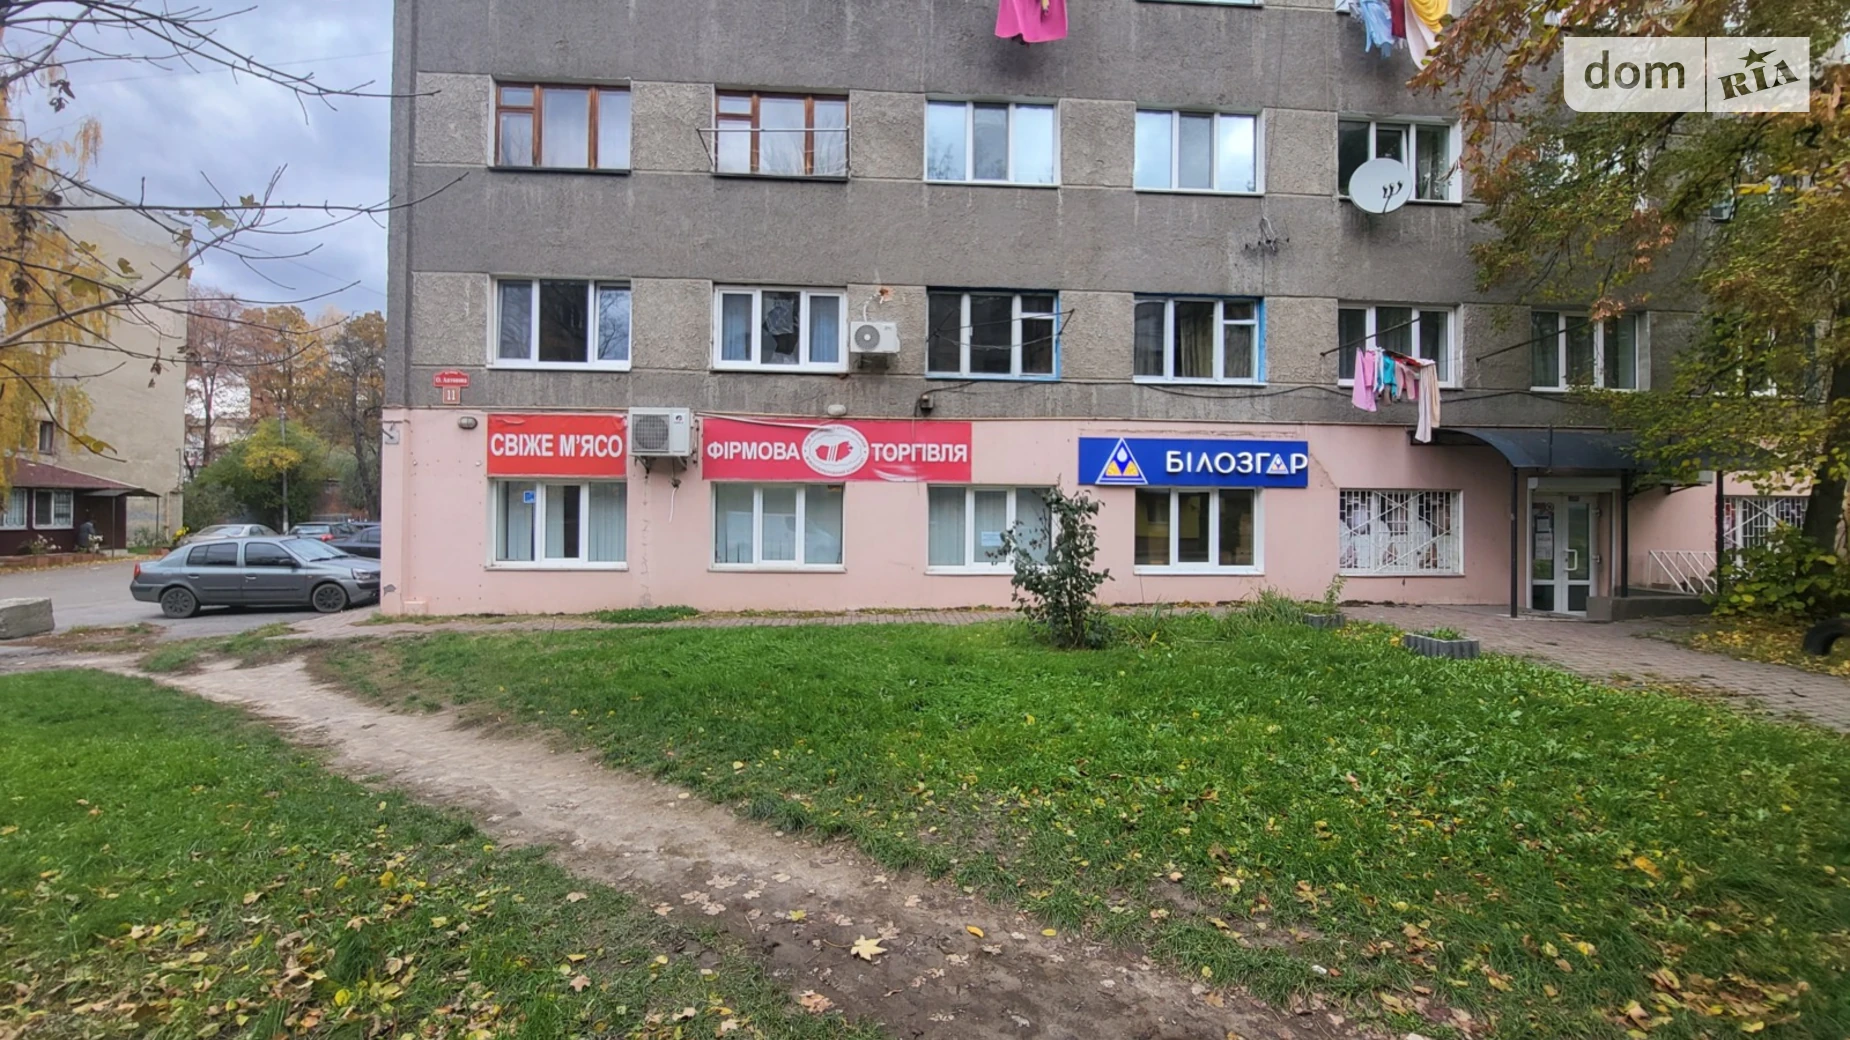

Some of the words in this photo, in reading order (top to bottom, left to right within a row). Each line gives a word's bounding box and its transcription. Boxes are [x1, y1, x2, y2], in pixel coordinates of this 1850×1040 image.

[447, 389, 456, 401] 11
[491, 433, 554, 456] СВІЖЕ
[560, 434, 623, 458] М'ЯСО
[707, 441, 801, 461] ФІРМОВА
[871, 443, 968, 462] ТОРГІВЛЯ
[1165, 450, 1309, 475] БІЛОЗГАР
